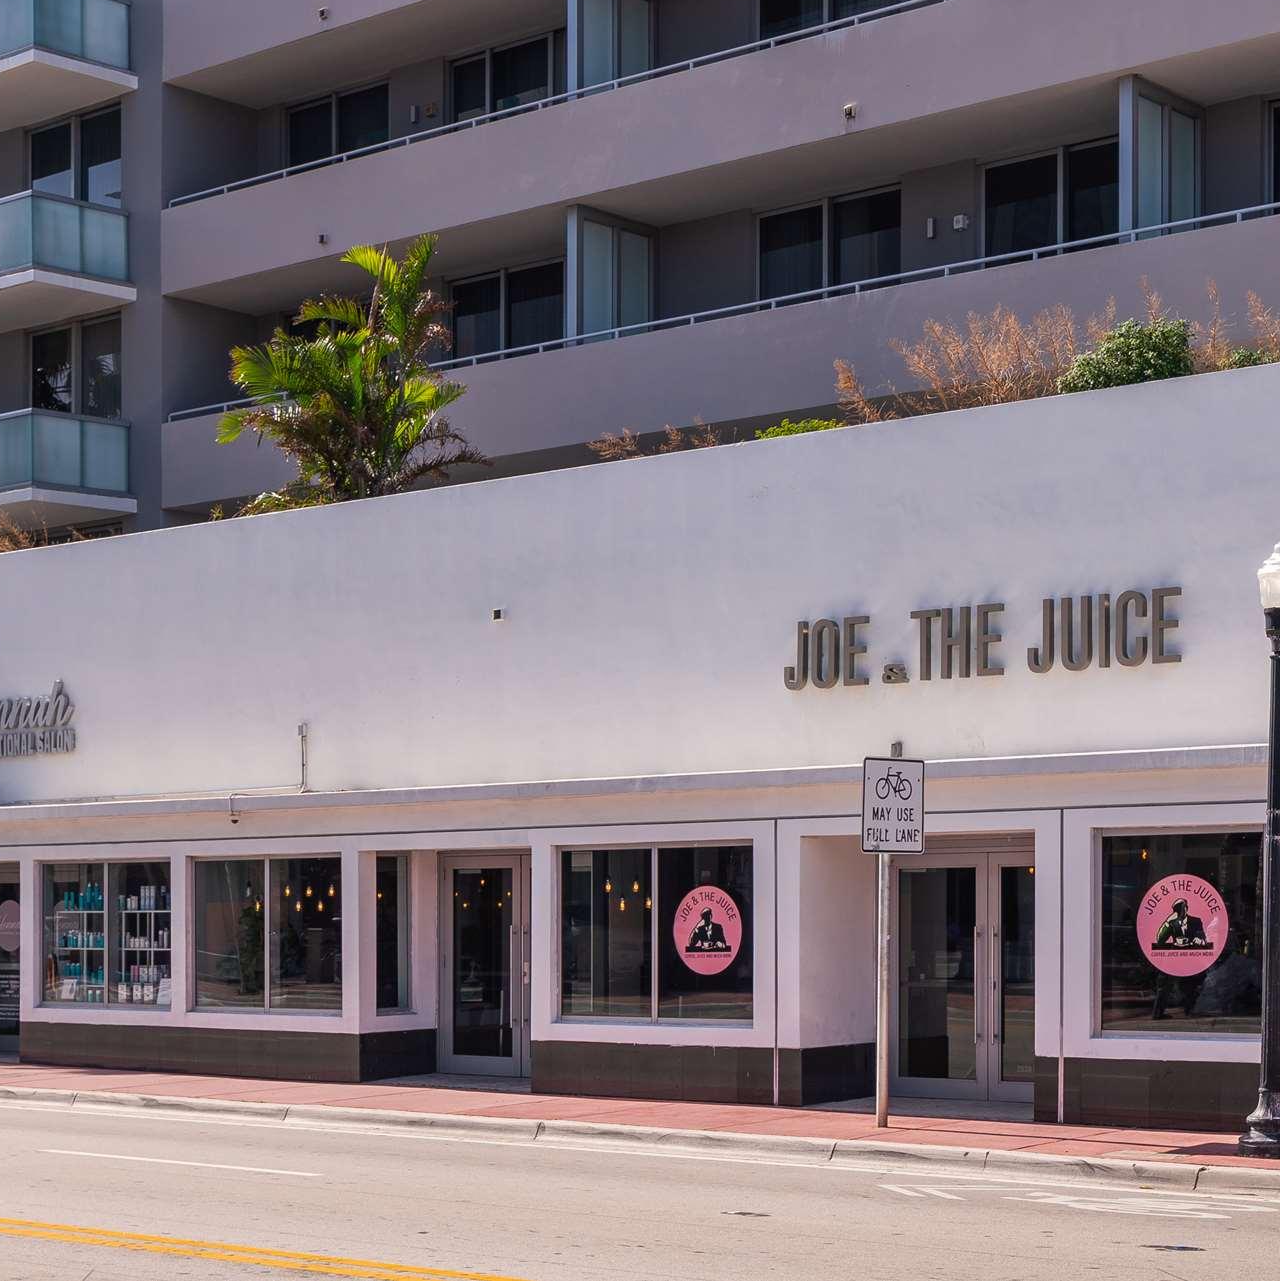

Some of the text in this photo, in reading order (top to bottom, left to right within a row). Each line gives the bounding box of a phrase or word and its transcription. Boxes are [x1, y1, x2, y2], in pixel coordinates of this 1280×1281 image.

[783, 586, 1182, 691] JOE & THE JUICE
[38, 728, 76, 754] SALON
[872, 807, 915, 822] MAY USE
[866, 828, 920, 842] FULL LANE
[680, 891, 737, 922] JOE & THE JUICE
[1144, 879, 1221, 915] JOE & THE JUICE
